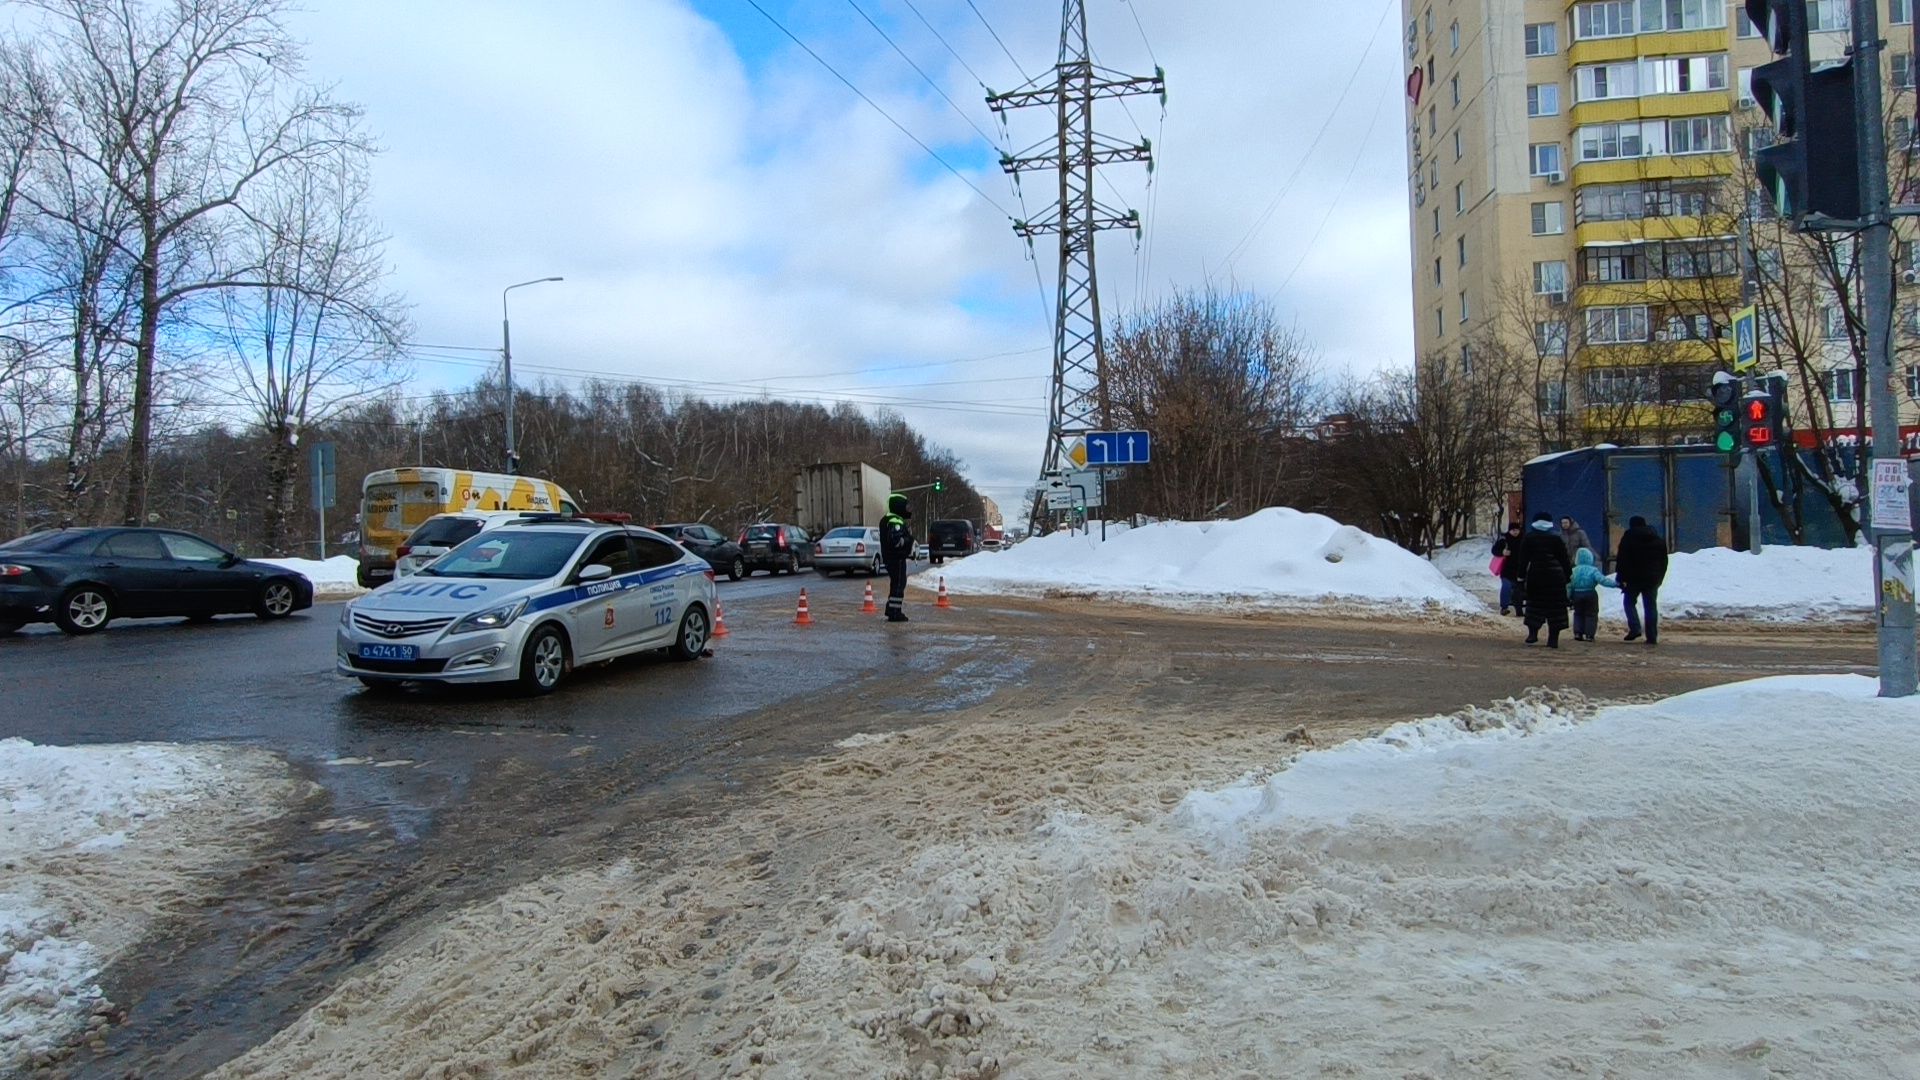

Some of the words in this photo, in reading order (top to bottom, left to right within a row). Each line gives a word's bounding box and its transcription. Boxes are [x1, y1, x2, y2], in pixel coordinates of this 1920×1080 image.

[379, 582, 487, 600] ДПС
[587, 580, 622, 596] ПОЛИЦИЯ
[654, 606, 673, 626] 112
[373, 645, 397, 657] 4741
[402, 645, 412, 656] 50
